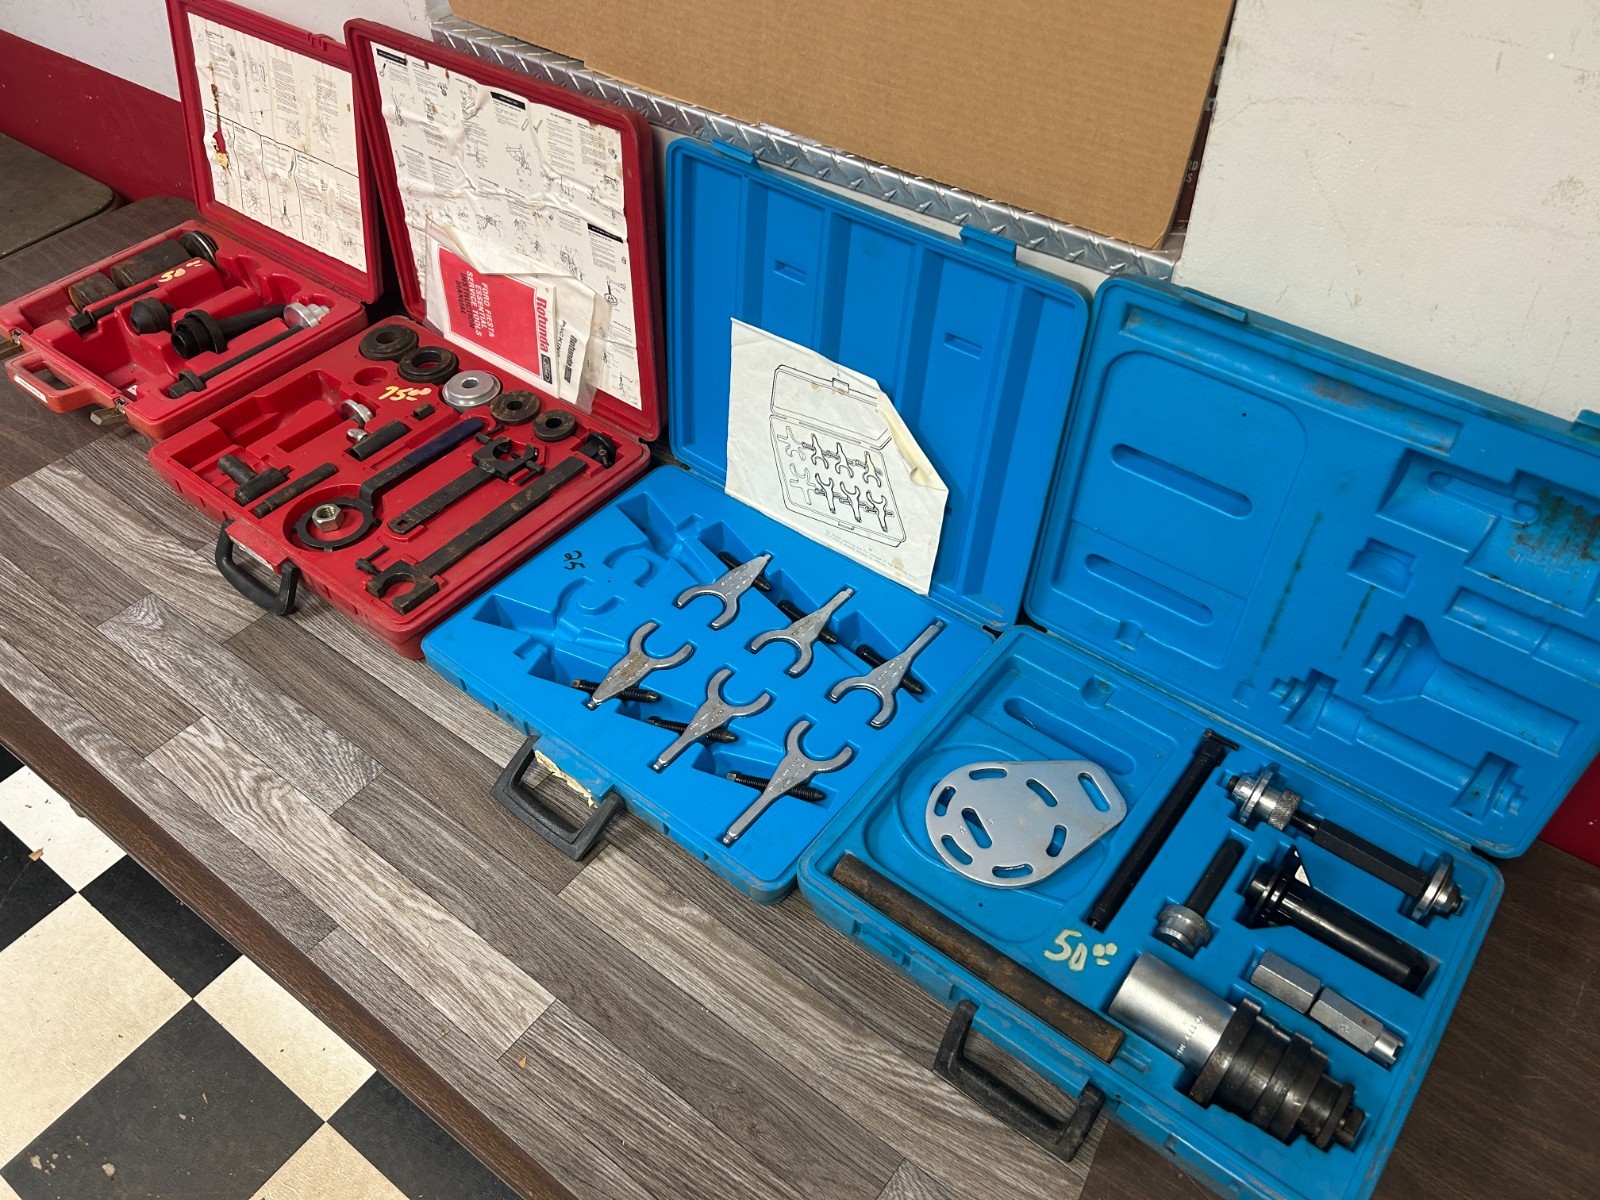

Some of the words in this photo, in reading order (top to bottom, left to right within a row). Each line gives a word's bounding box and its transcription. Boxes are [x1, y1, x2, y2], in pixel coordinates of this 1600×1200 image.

[455, 280, 466, 315] MANUAL
[460, 272, 475, 329] INSTRUCTION
[467, 270, 477, 308] SERVICE
[473, 309, 482, 337] TOOLS
[475, 284, 487, 329] ESSENTIAL
[482, 282, 491, 307] FORD
[485, 309, 495, 337] FIESTA
[537, 297, 549, 354] Rotunda
[566, 335, 578, 367] Rotunda
